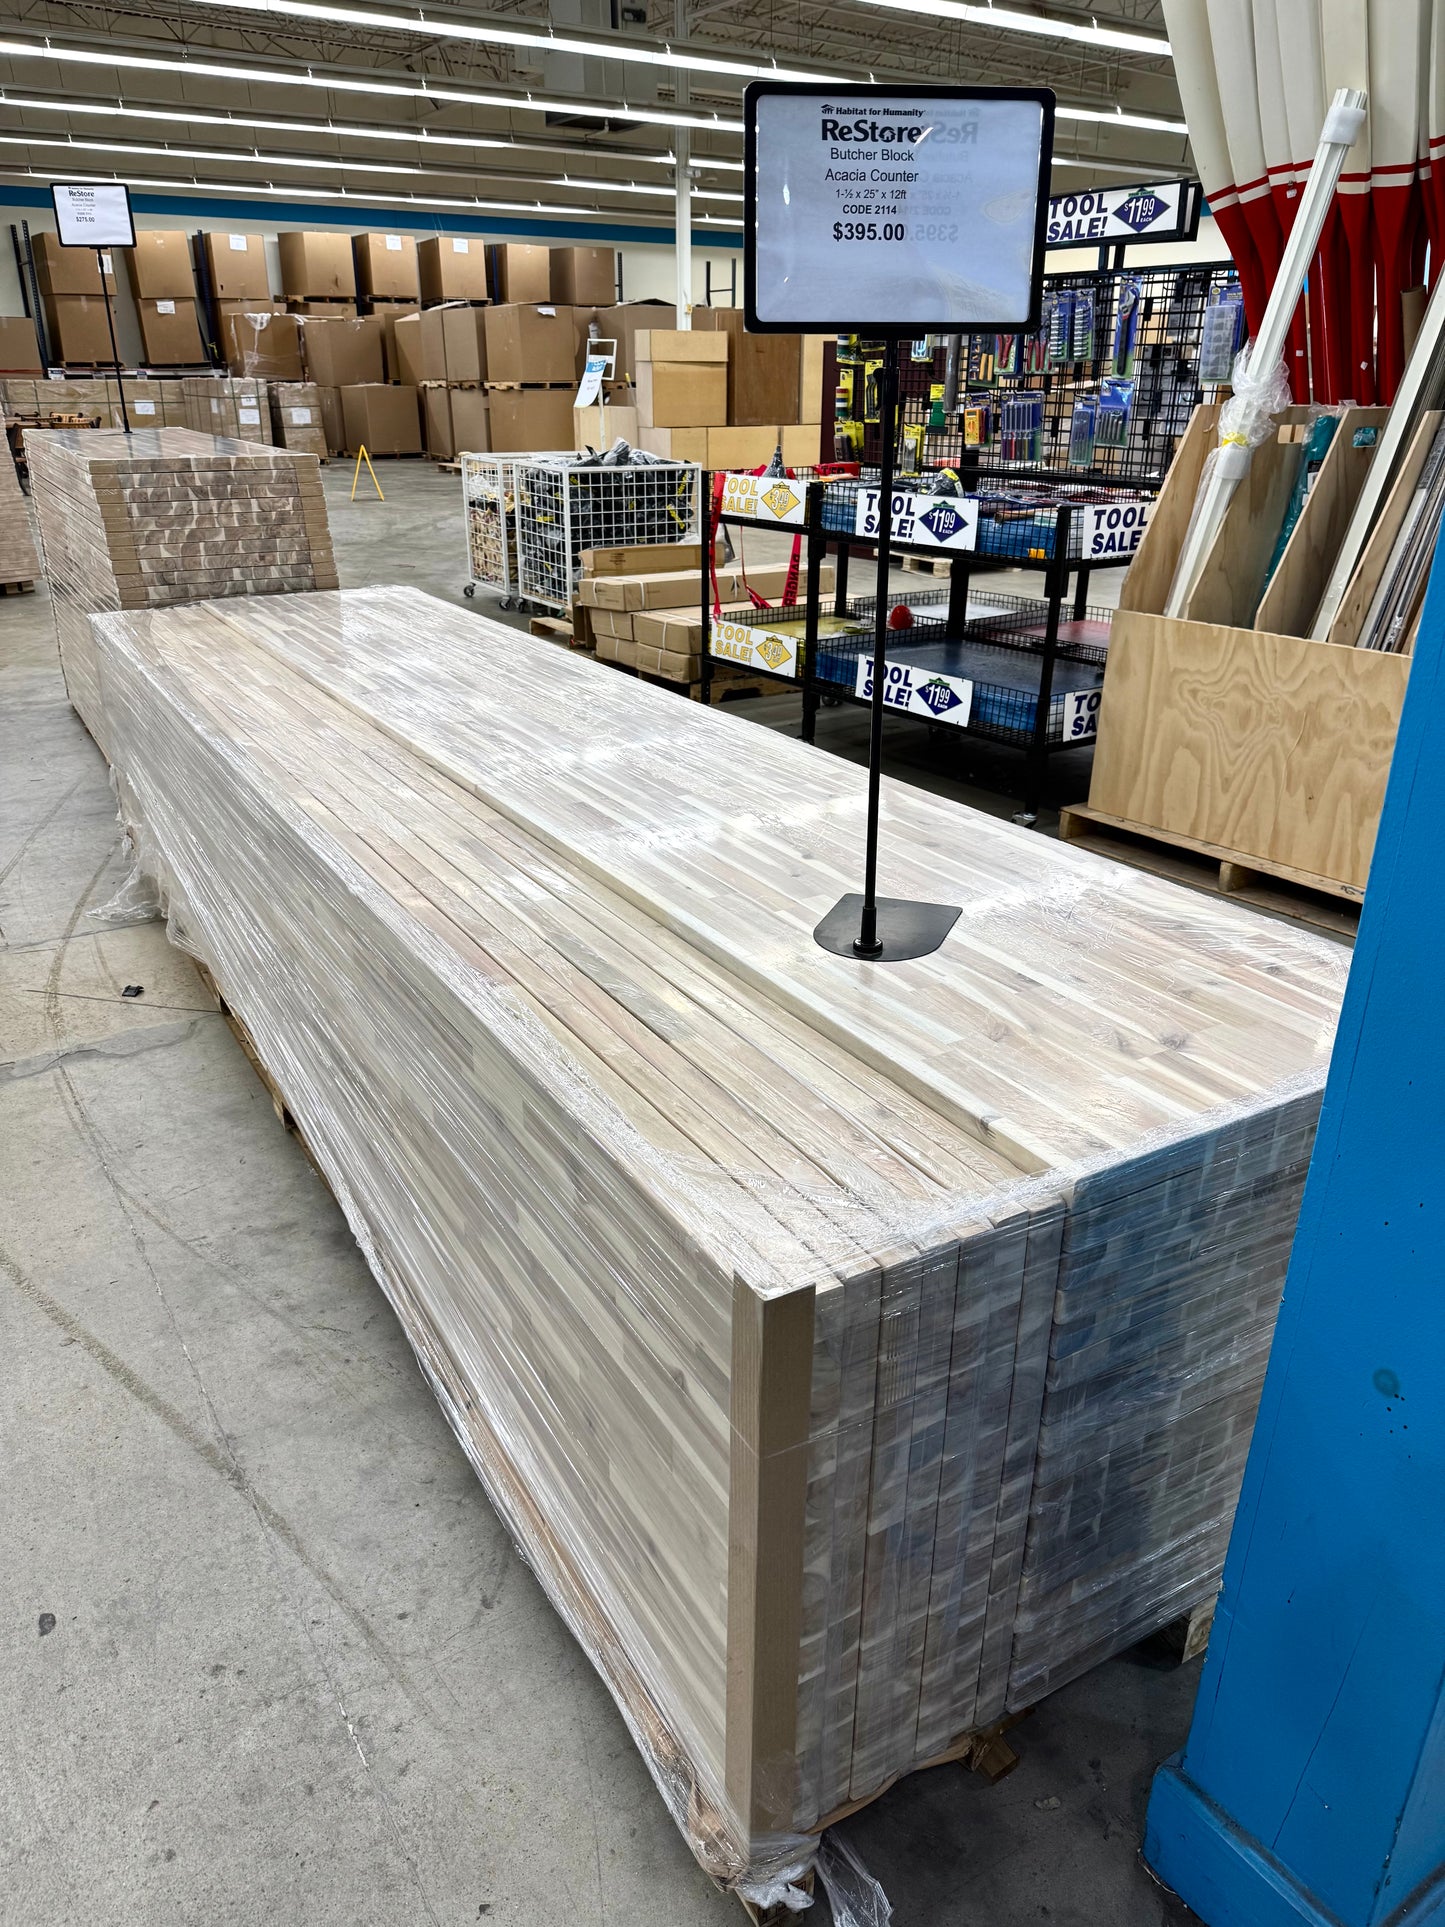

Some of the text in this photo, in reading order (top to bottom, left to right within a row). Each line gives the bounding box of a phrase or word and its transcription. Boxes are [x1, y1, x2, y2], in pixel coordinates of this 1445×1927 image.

[836, 107, 867, 115] Habitat
[869, 107, 881, 115] for
[883, 108, 924, 118] Humanity
[821, 118, 922, 143] ReStore
[830, 147, 914, 161] Butcher Block
[825, 168, 919, 182] Acacia Counter
[855, 191, 861, 199] x
[881, 191, 887, 199] x
[890, 189, 907, 200] 12ft
[1048, 193, 1108, 219] TOOL
[842, 204, 872, 215] CODE
[874, 205, 897, 215] 2114
[832, 221, 905, 242] $395.00
[1047, 216, 1108, 242] SALE!
[725, 477, 758, 496] OOL
[866, 493, 915, 517] TOL
[1093, 506, 1148, 530] TOOL
[1091, 530, 1142, 554] SALE
[716, 623, 753, 645] TOOL
[715, 640, 753, 663] SALE!
[863, 679, 912, 707] SLE!
[1074, 691, 1102, 715] TO
